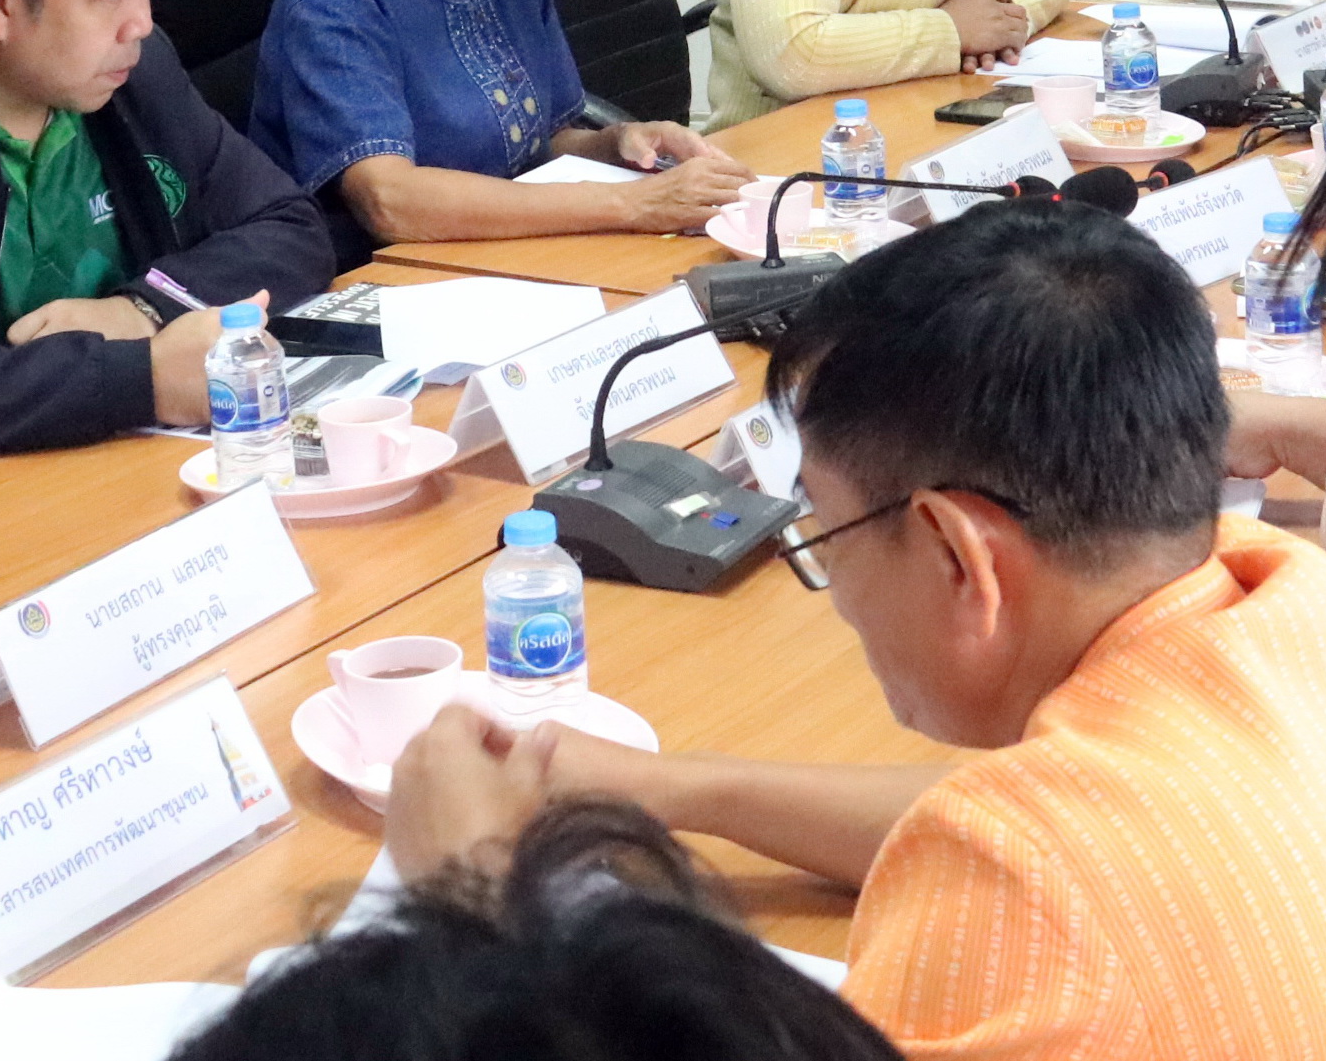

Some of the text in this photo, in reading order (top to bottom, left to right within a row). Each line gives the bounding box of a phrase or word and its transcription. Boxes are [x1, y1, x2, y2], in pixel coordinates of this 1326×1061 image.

[84, 543, 229, 629] นายสถาน แสนสุข
[131, 593, 228, 672] ผู้ทรงคุณวุฒิ
[52, 726, 154, 809] ศรีหาวงษ์
